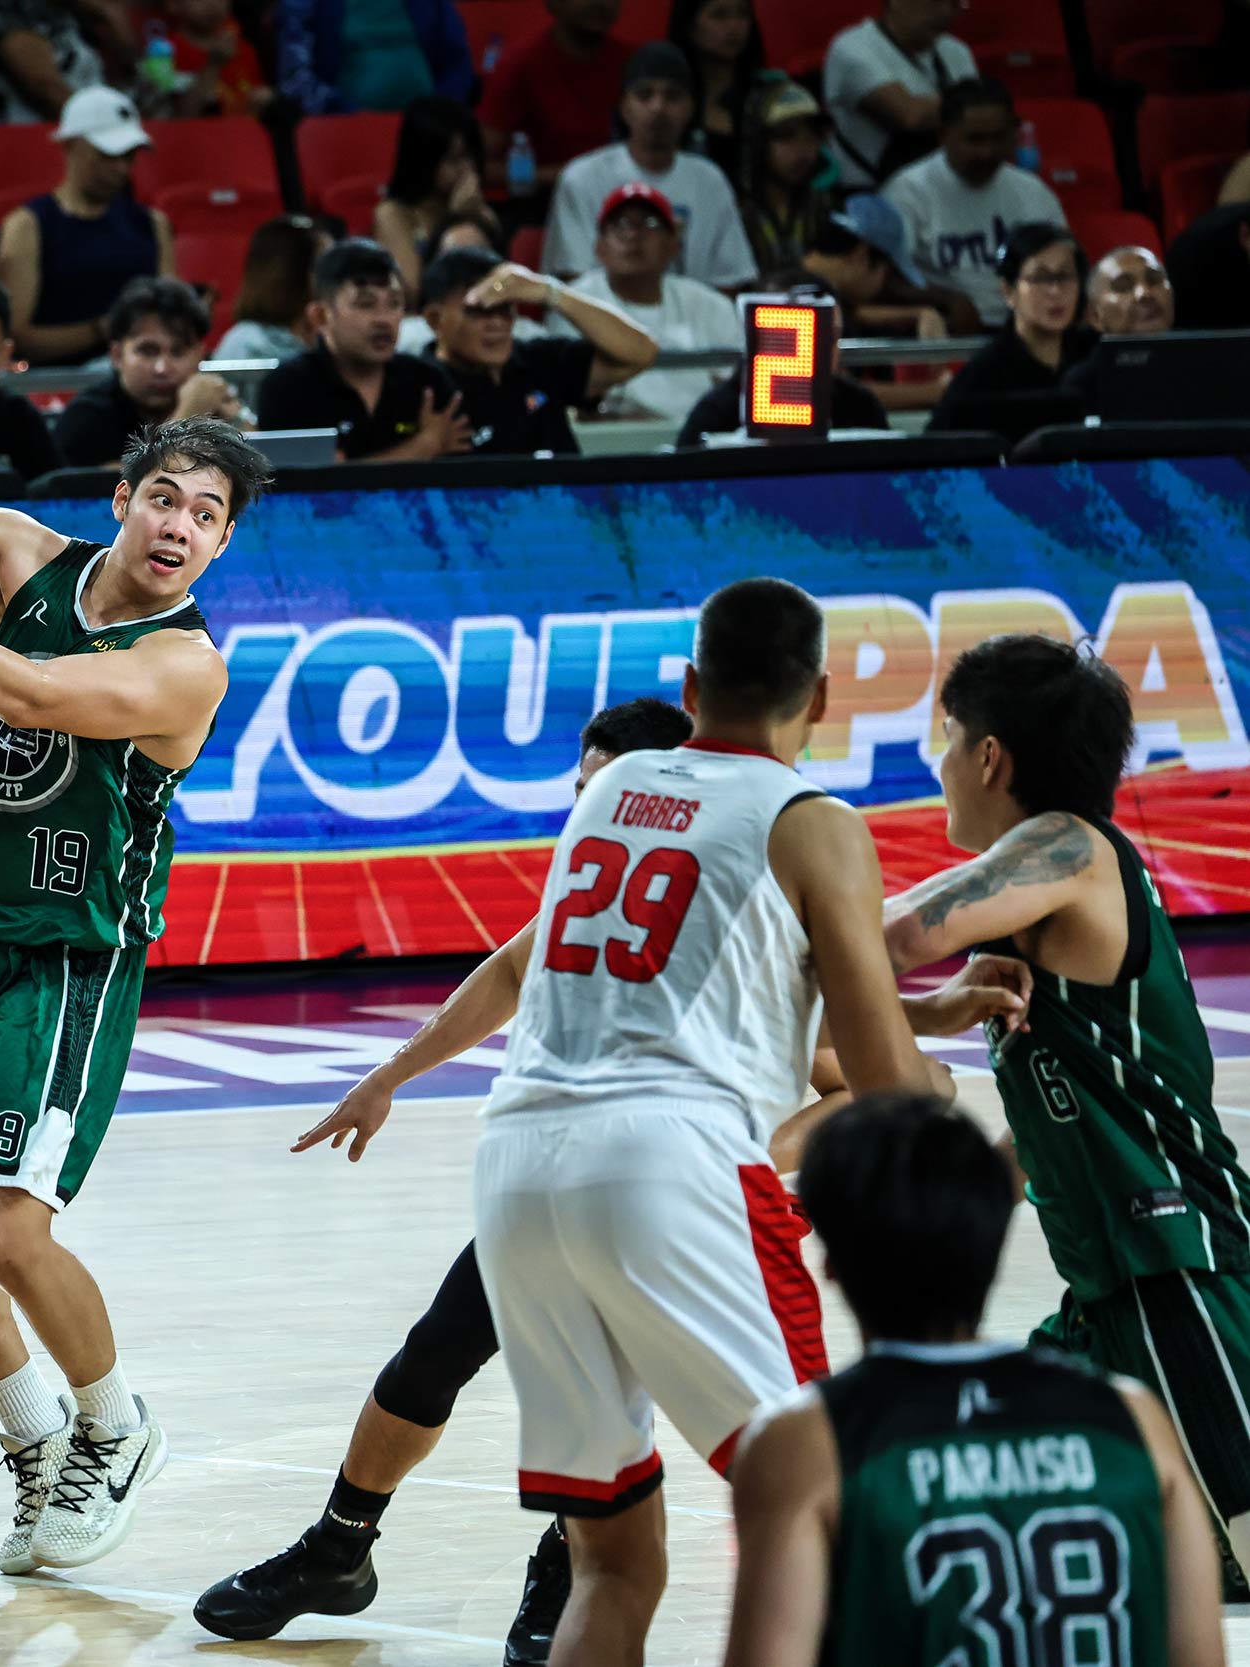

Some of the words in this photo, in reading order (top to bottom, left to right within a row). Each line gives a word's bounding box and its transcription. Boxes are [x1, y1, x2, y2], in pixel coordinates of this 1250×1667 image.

[752, 306, 816, 426] 2
[612, 790, 701, 833] TORRES
[27, 826, 90, 897] 19
[543, 836, 700, 982] 29
[1029, 1048, 1081, 1123] 6
[907, 1433, 1097, 1506] PARAISO
[904, 1504, 1131, 1667] 38
